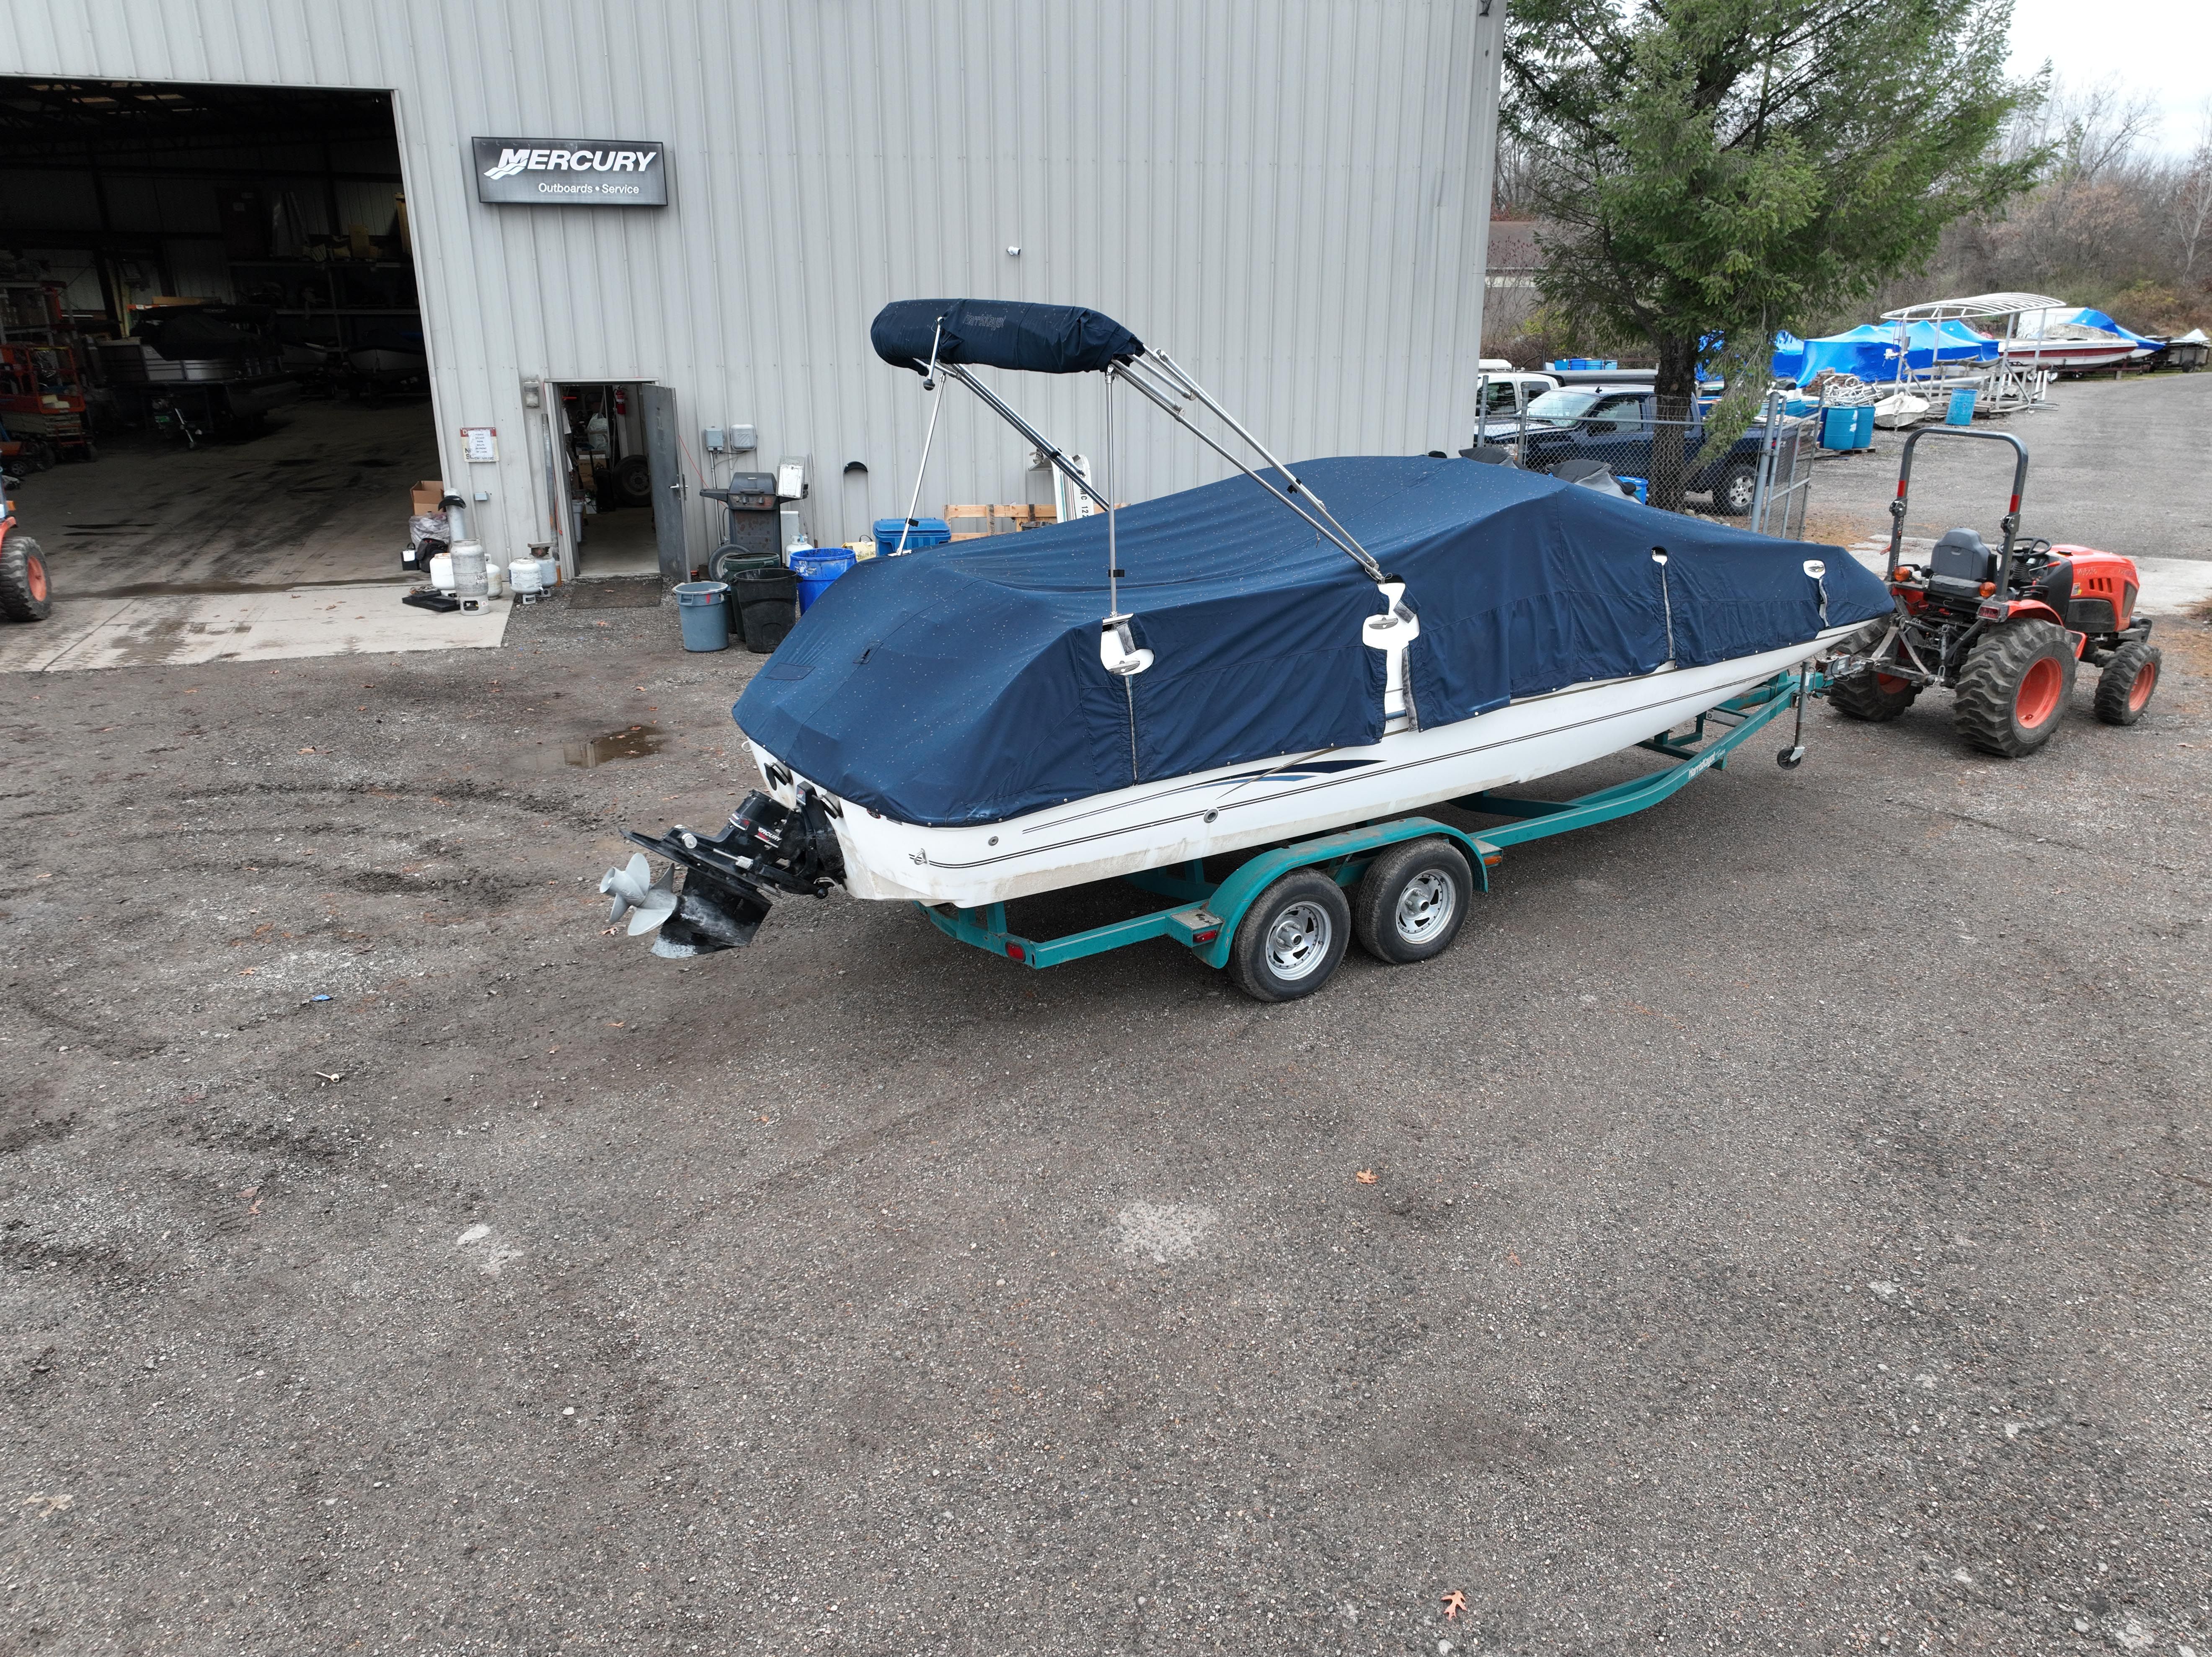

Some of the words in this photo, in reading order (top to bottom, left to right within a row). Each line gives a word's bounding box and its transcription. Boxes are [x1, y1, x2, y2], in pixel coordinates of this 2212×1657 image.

[496, 148, 657, 172] MERCURY
[538, 183, 593, 194] Outboards
[602, 184, 639, 194] Service
[758, 827, 782, 841] ERCURY
